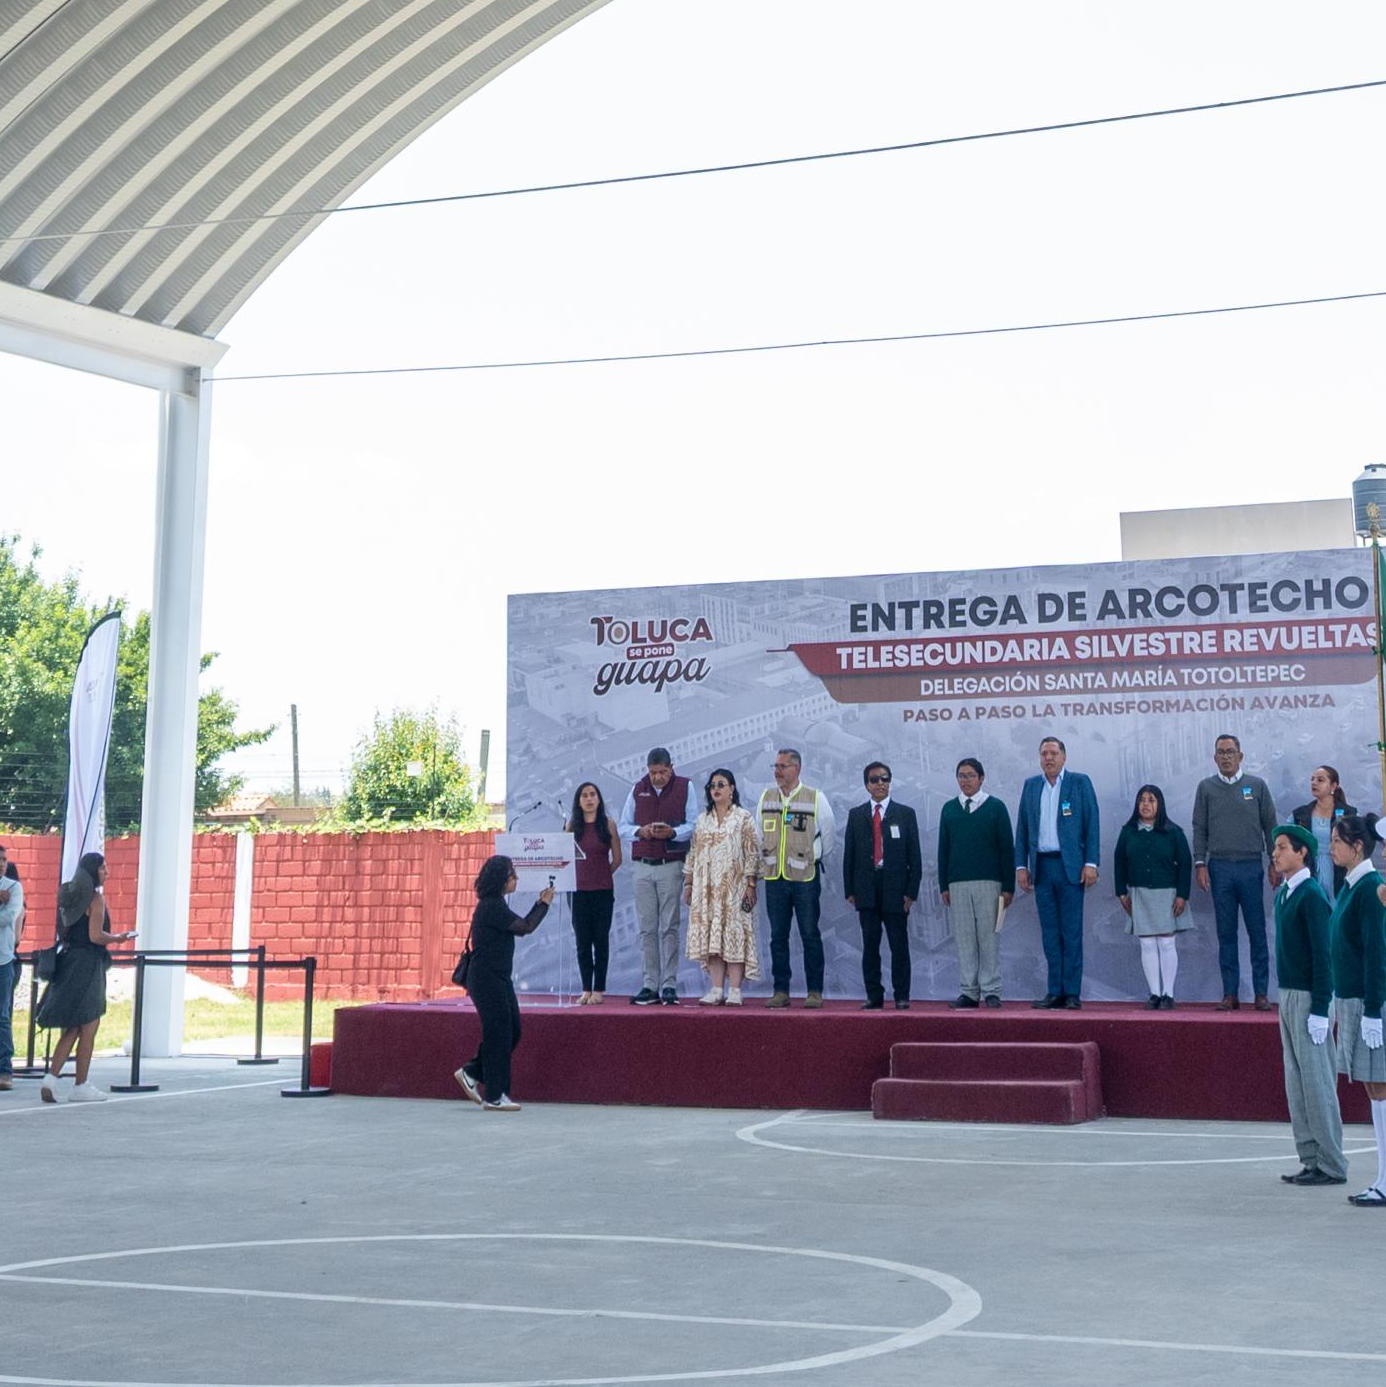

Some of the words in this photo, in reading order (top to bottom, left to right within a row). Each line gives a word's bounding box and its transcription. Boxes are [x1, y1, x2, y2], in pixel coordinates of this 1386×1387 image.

[849, 594, 1028, 633] ENTREGA
[1037, 591, 1087, 624] DE
[1096, 576, 1370, 621] ARCOTECHO
[590, 616, 713, 646] TOLUCA
[836, 637, 1071, 670] TELESECUNDARIA
[1075, 629, 1217, 660] SILVESTRE
[1223, 622, 1382, 653] REVUELTAS
[629, 647, 643, 657] se
[644, 645, 673, 657] pone
[593, 657, 711, 696] guapa
[920, 671, 1040, 696] DELEGACIÓN
[1044, 671, 1109, 691] SANTA
[1112, 665, 1177, 688] MARÍA
[1180, 663, 1307, 686] TOTOLTEPEC
[903, 707, 954, 723] PASO
[957, 707, 972, 721] A
[975, 704, 1027, 720] PASO
[1031, 704, 1056, 718] LA
[1060, 693, 1245, 717] TRANSFORMACIÓN
[1249, 693, 1336, 711] AVANZA
